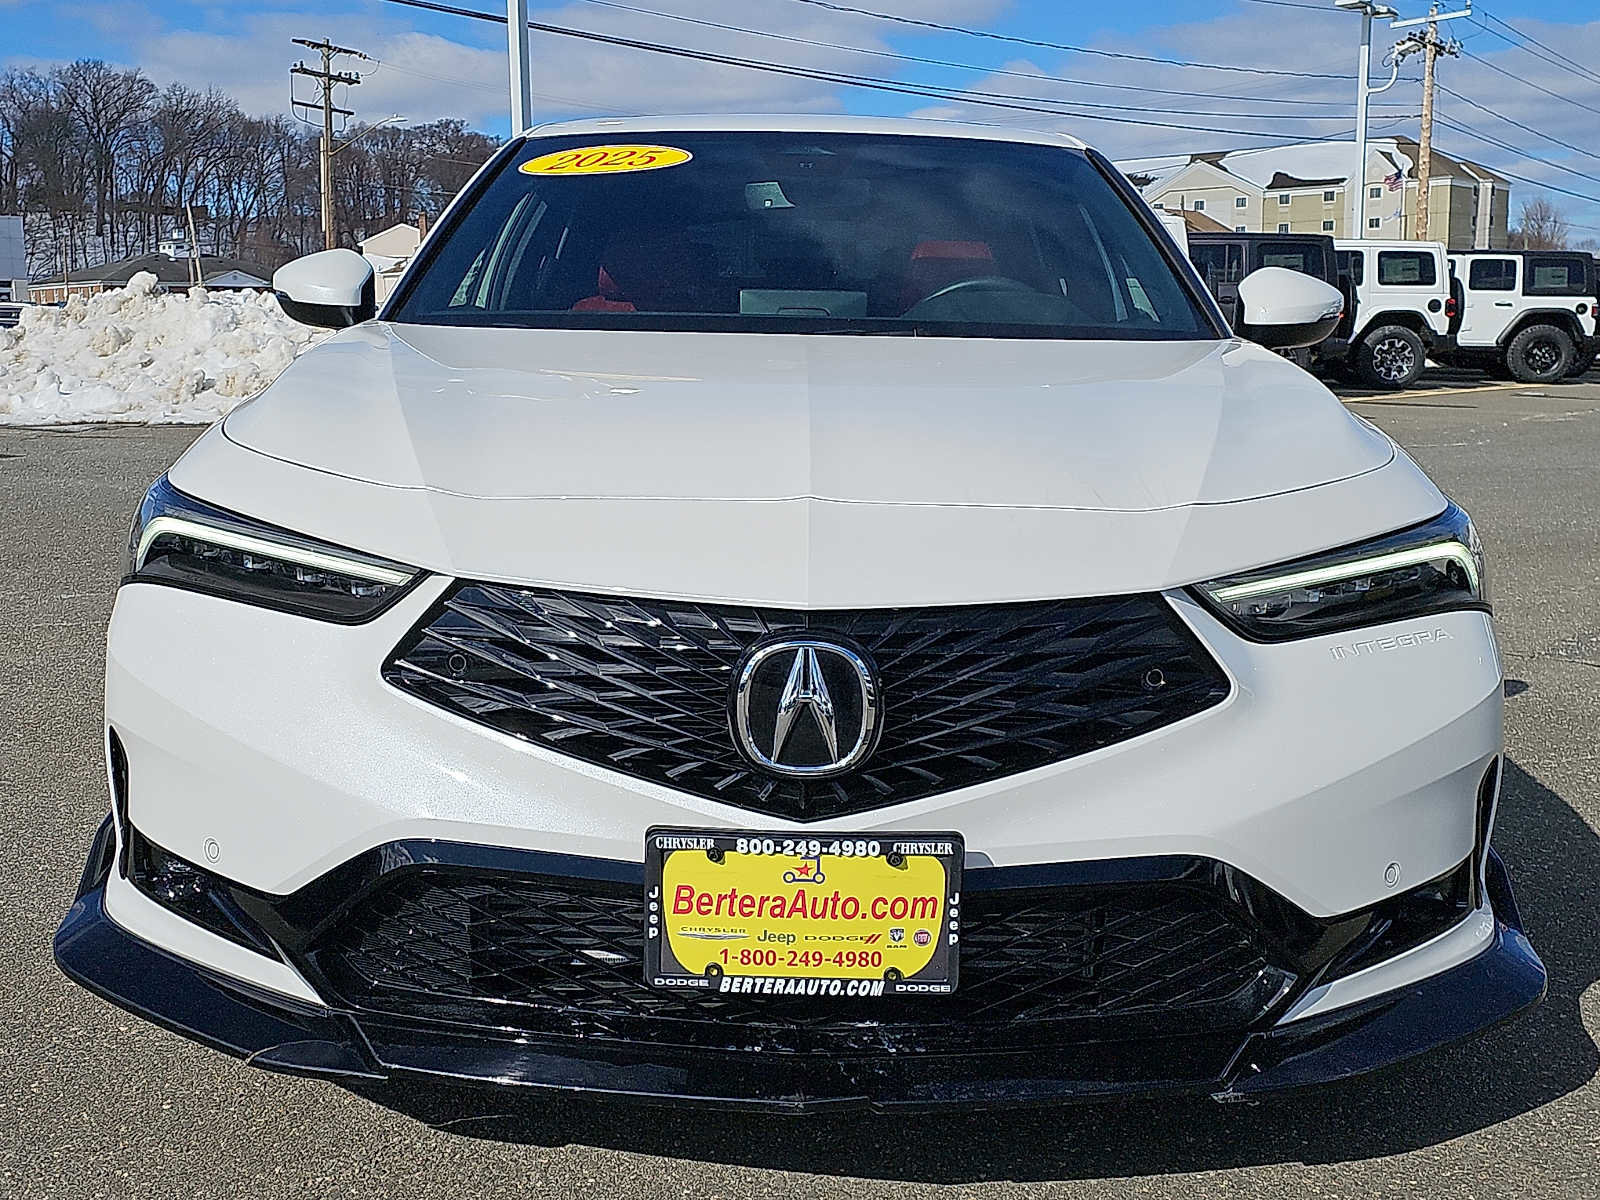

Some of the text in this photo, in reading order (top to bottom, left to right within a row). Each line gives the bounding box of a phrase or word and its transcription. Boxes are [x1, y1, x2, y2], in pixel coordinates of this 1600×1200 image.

[544, 151, 666, 171] 2025
[1329, 628, 1454, 661] INTEGRA
[655, 836, 715, 850] CHRYSLER
[736, 838, 880, 857] 800-249-4980
[892, 842, 954, 855] CHRYSLER
[648, 886, 659, 939] Jeep
[672, 885, 939, 921] BerteraAuto.com
[949, 892, 960, 946] Jeep
[680, 926, 746, 934] CHRYSLER
[757, 930, 795, 946] Jeep
[719, 948, 882, 968] 1-800-249-4980
[653, 977, 710, 987] DODGE
[719, 976, 886, 997] BERTERAAUTO.COM
[895, 984, 951, 993] DODGE
